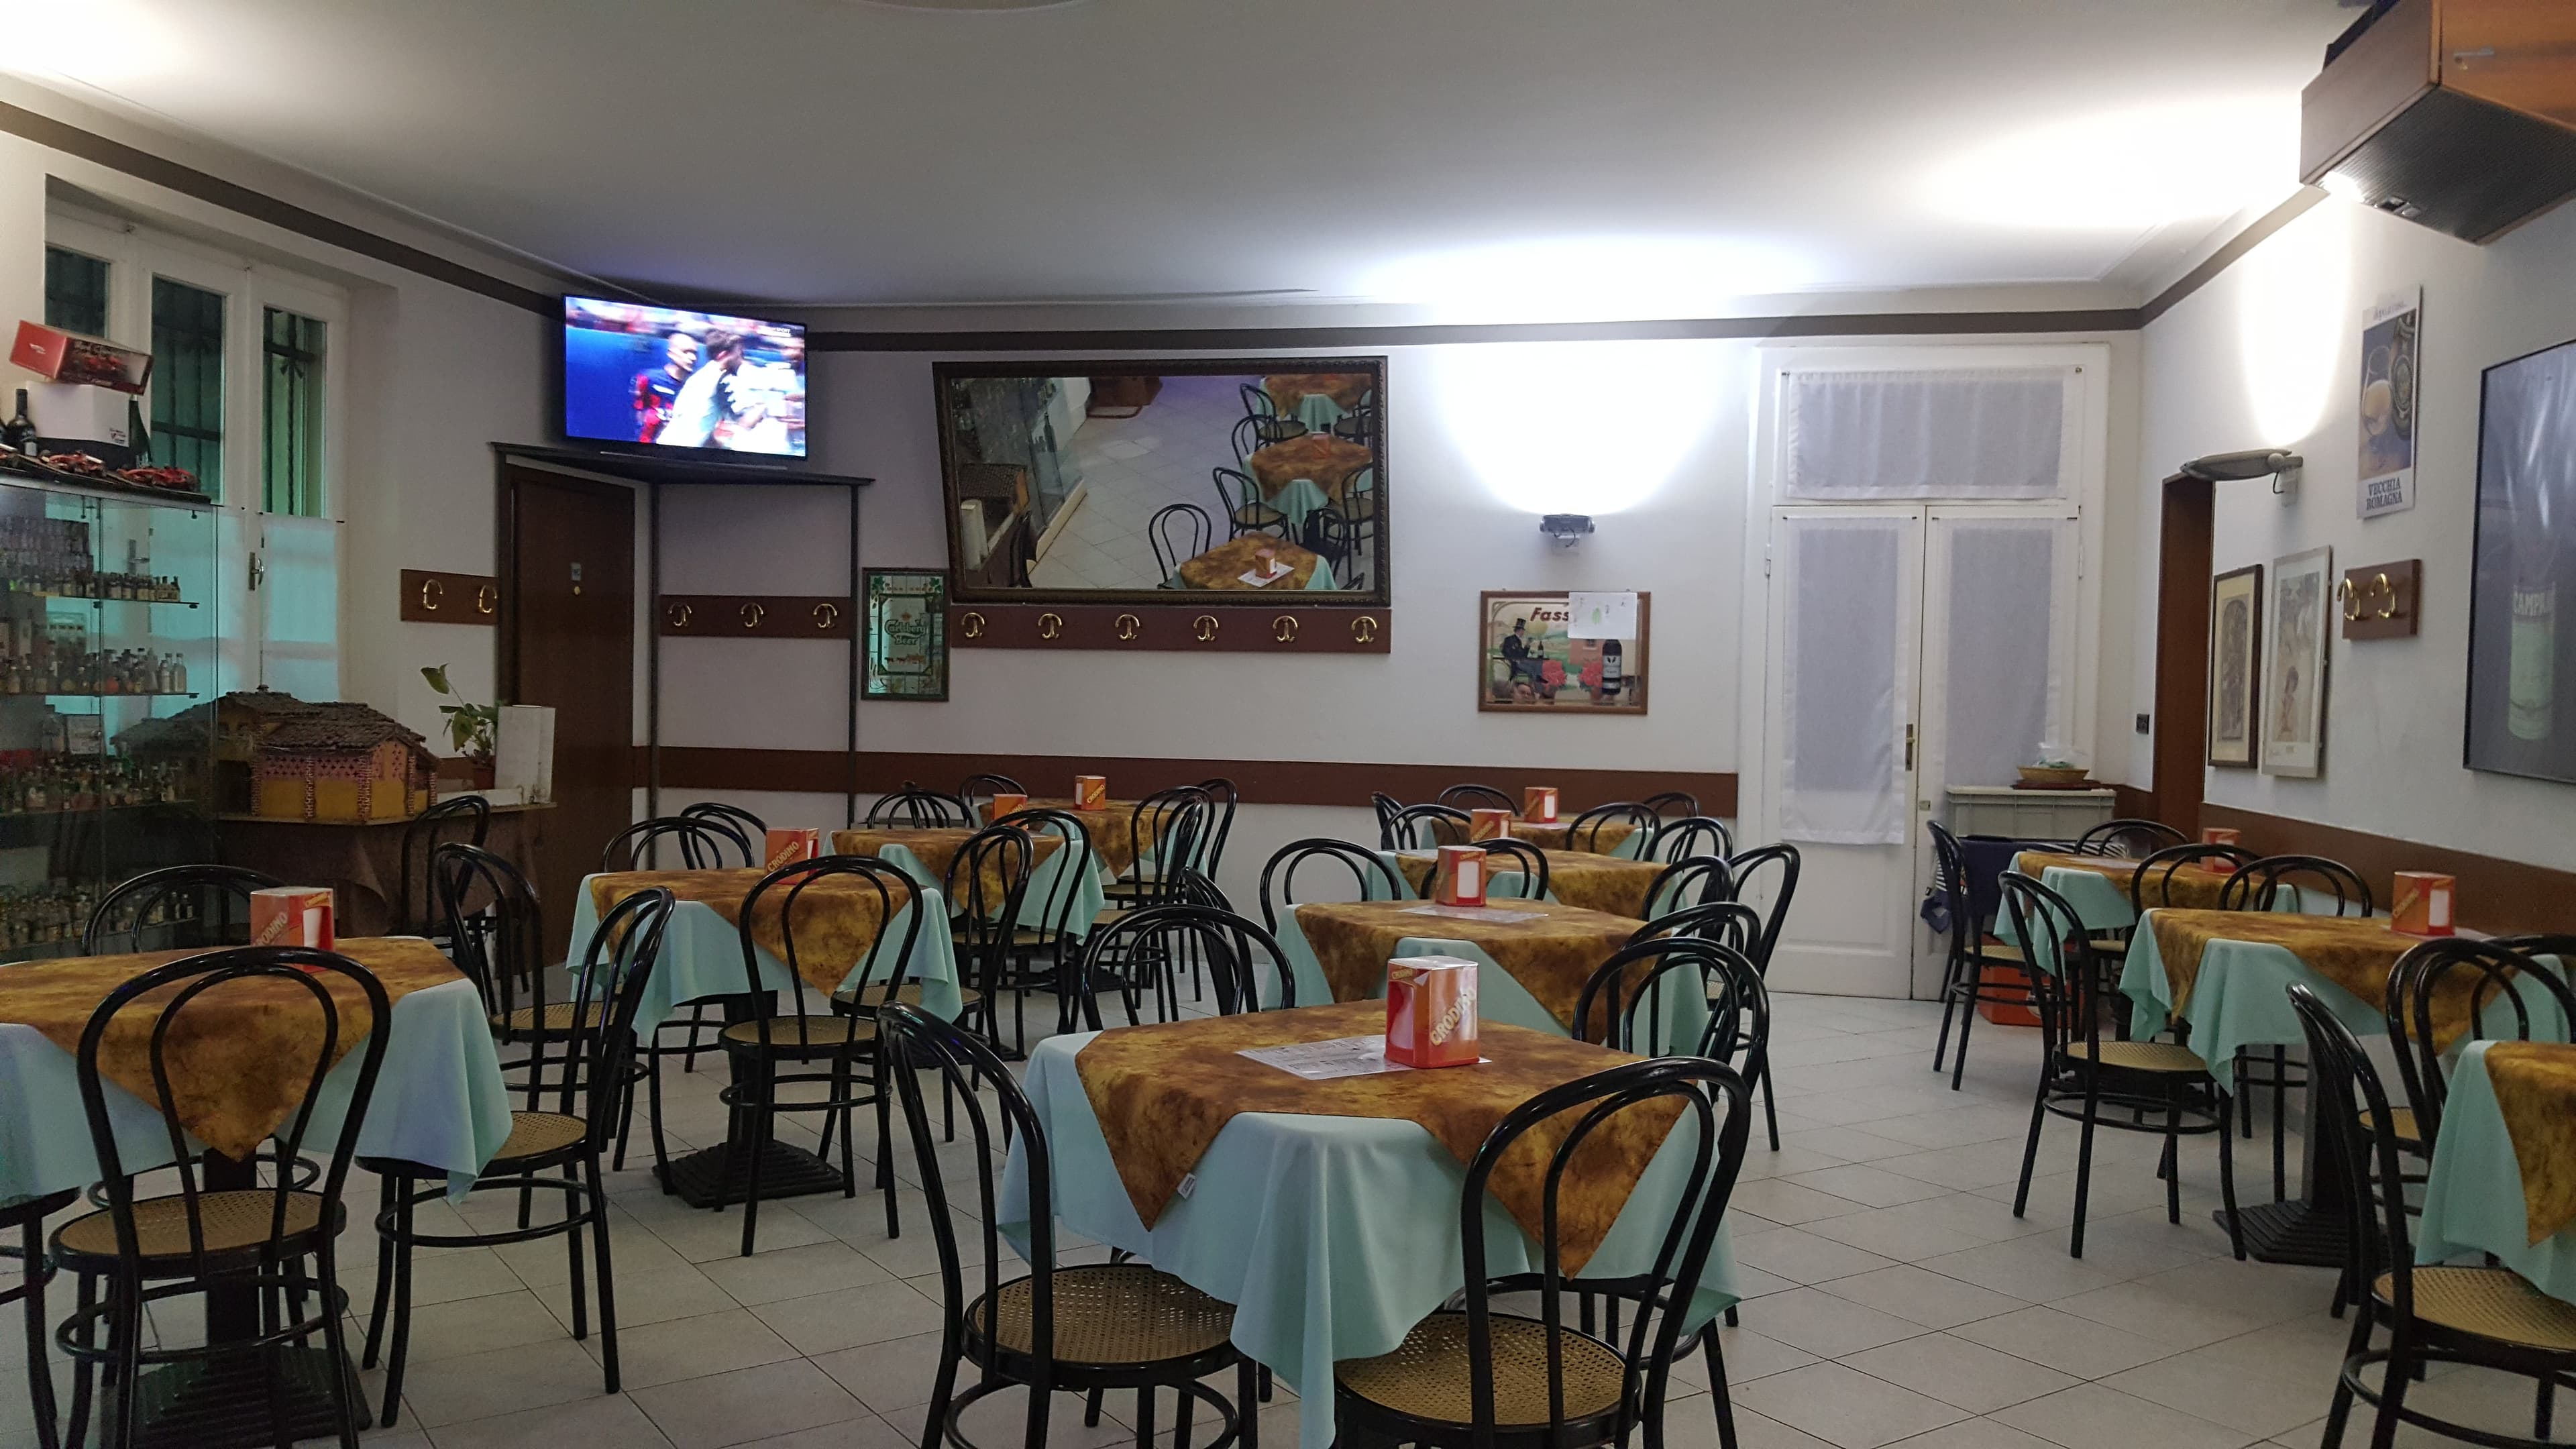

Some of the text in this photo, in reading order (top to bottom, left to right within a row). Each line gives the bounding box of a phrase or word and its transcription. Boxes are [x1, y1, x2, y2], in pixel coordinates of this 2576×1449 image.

[2368, 477, 2400, 496] VECCHIA
[2366, 490, 2402, 511] ROMAGNA
[884, 619, 927, 637] Carlsberg
[895, 635, 918, 645] Beer
[767, 841, 799, 871] CRODINO
[254, 912, 288, 947] RODINO
